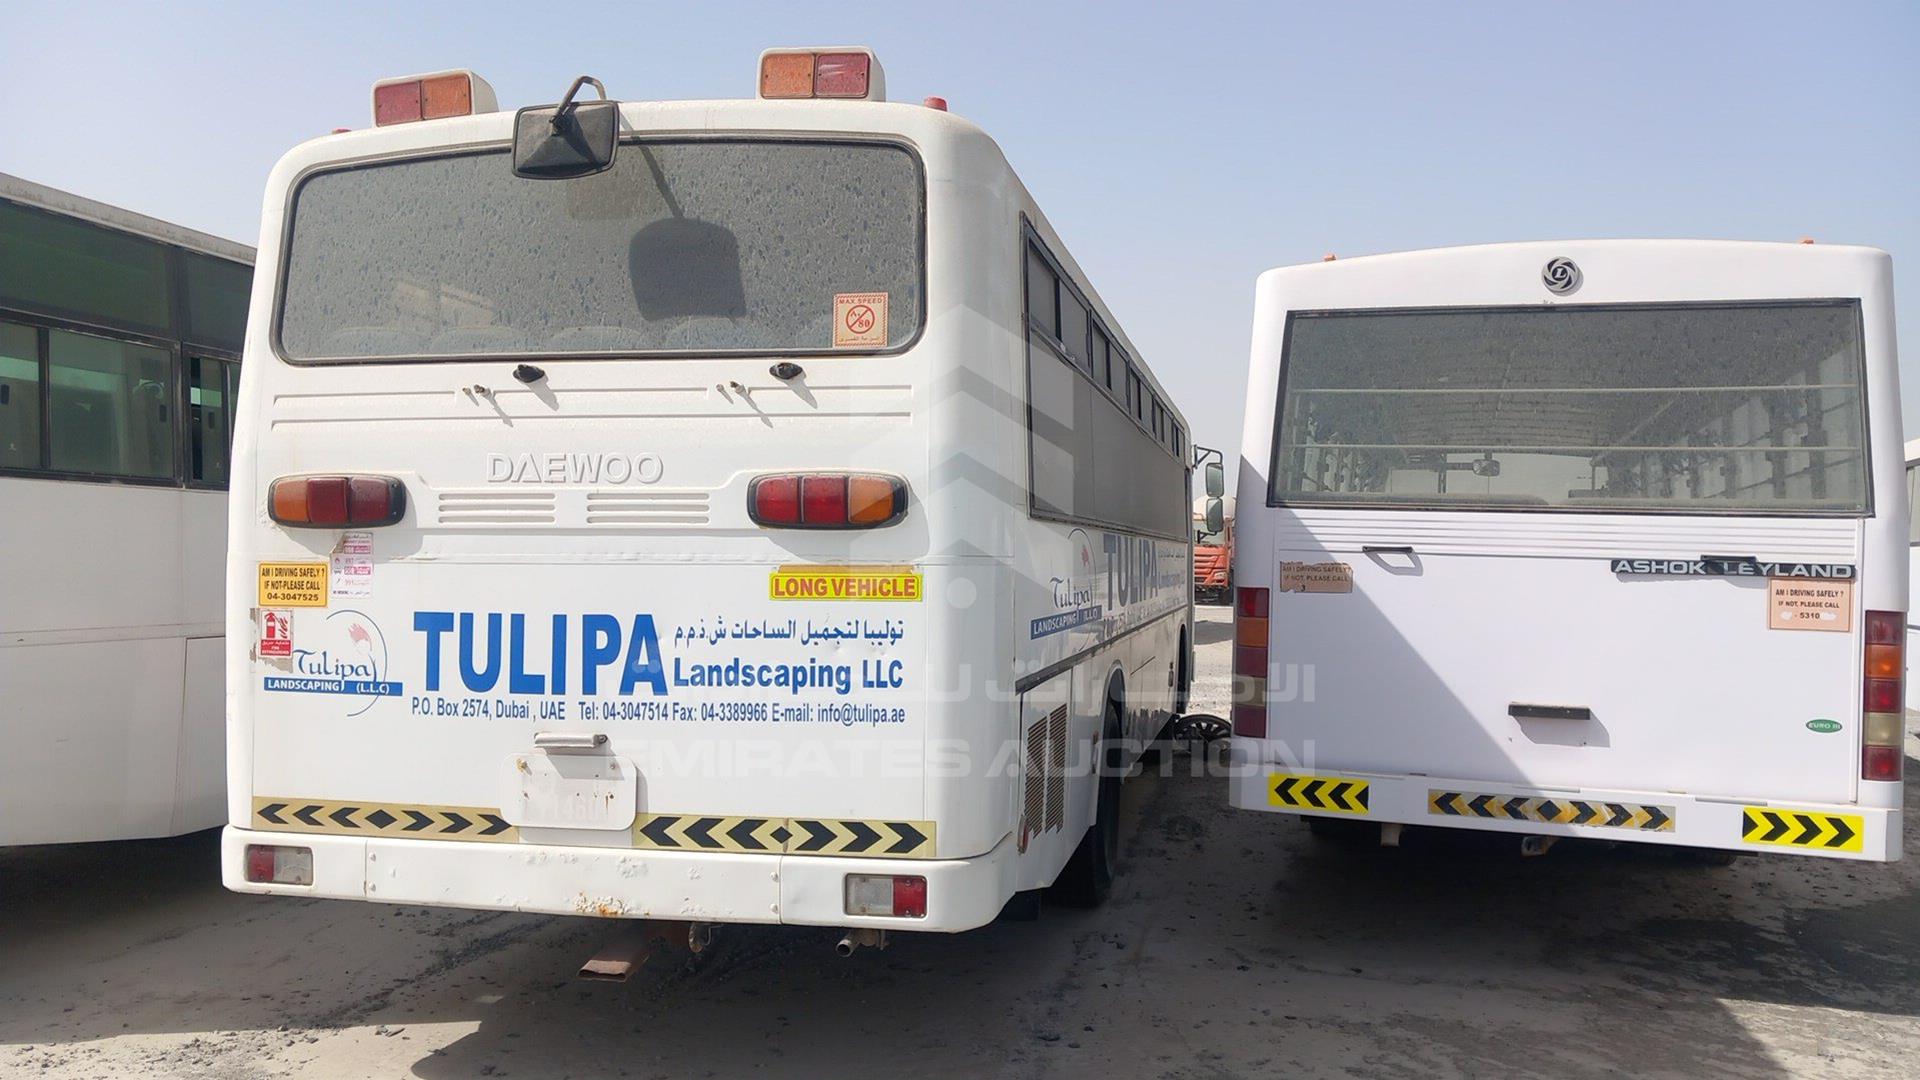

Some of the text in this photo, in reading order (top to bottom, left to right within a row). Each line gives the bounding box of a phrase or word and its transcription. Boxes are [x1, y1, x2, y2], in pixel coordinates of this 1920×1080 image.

[858, 319, 870, 328] 80
[487, 452, 664, 485] DAEWOO
[261, 567, 270, 577] AM
[275, 567, 298, 577] DRIVING
[299, 567, 319, 578] SAFELY
[1103, 533, 1158, 612] TULIPA
[1614, 560, 1852, 578] ASHOK LEYLAND
[265, 580, 270, 590] IF
[306, 581, 320, 590] CALL
[774, 577, 917, 597] LONG VEHICLE
[1049, 576, 1091, 610] Tulipa
[1790, 589, 1815, 597] DRIVING
[1817, 590, 1838, 598] SAFELY
[267, 592, 319, 602] 04-3047525
[1799, 612, 1820, 620] 5310
[731, 619, 796, 639] الساحات
[800, 619, 860, 646] لتجميل
[863, 620, 904, 646] توليبا
[413, 611, 668, 696] TULIPA
[292, 650, 371, 686] Tulipa
[673, 657, 851, 695] Landscaping
[862, 659, 904, 688] LLC
[267, 679, 390, 694] LANDSCAPING (L.L.C)
[411, 696, 433, 715] P.O.
[437, 698, 459, 717] Box
[462, 698, 492, 721] 2574,
[495, 699, 530, 720] Dubai
[540, 700, 566, 720] UAE
[578, 701, 599, 721] Tel:
[602, 701, 668, 721] 04-3047514
[672, 702, 697, 722] Fax:
[700, 702, 768, 723] 04-3389966
[771, 702, 814, 723] E-mail:
[816, 702, 906, 727] info@tulipa.ae
[1808, 722, 1831, 730] EURO
